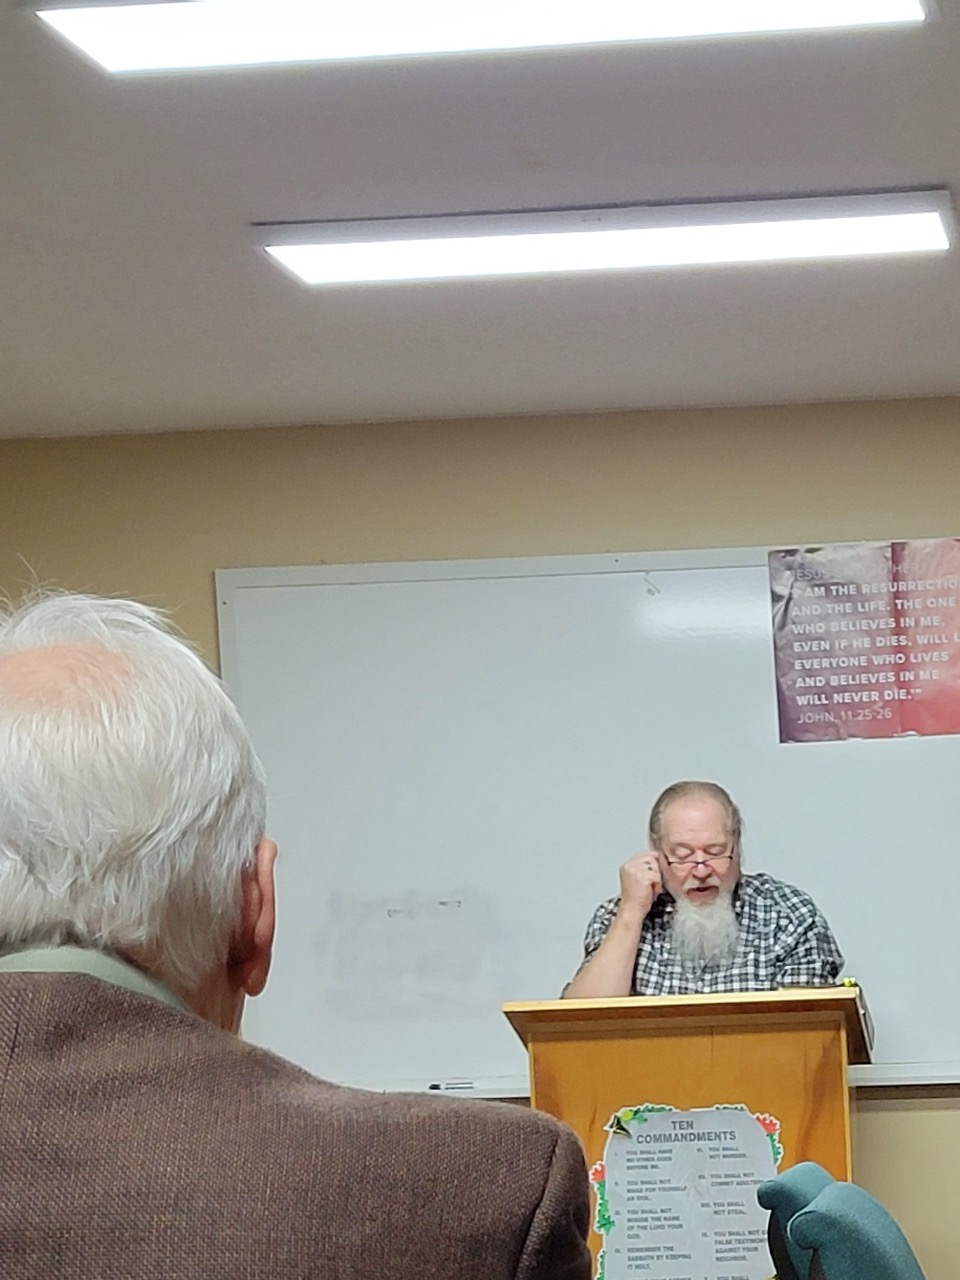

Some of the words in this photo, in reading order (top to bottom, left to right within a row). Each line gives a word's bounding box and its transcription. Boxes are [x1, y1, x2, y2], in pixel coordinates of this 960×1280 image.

[804, 585, 826, 597] AM
[830, 584, 857, 596] THE
[792, 604, 820, 617] AND
[826, 603, 853, 614] THE
[895, 599, 922, 610] THE
[926, 597, 957, 608] ONE
[792, 623, 825, 634] WHO
[831, 618, 896, 632] BELIEVES
[900, 617, 915, 628] IN
[793, 640, 830, 652] EVEN
[835, 639, 848, 650] IF
[853, 638, 871, 648] HE
[916, 633, 949, 645] WILL
[794, 656, 868, 670] EVERYONE
[872, 653, 906, 665] WHO
[910, 651, 949, 663] LIVES
[795, 676, 825, 688] AND
[829, 671, 896, 686] BELIEVES
[900, 670, 914, 681] IN
[919, 670, 939, 680] ME
[795, 694, 829, 706] WILL
[833, 691, 880, 704] NEVER
[671, 1120, 694, 1130] TEN
[636, 1131, 737, 1143] COMMANDMENTS
